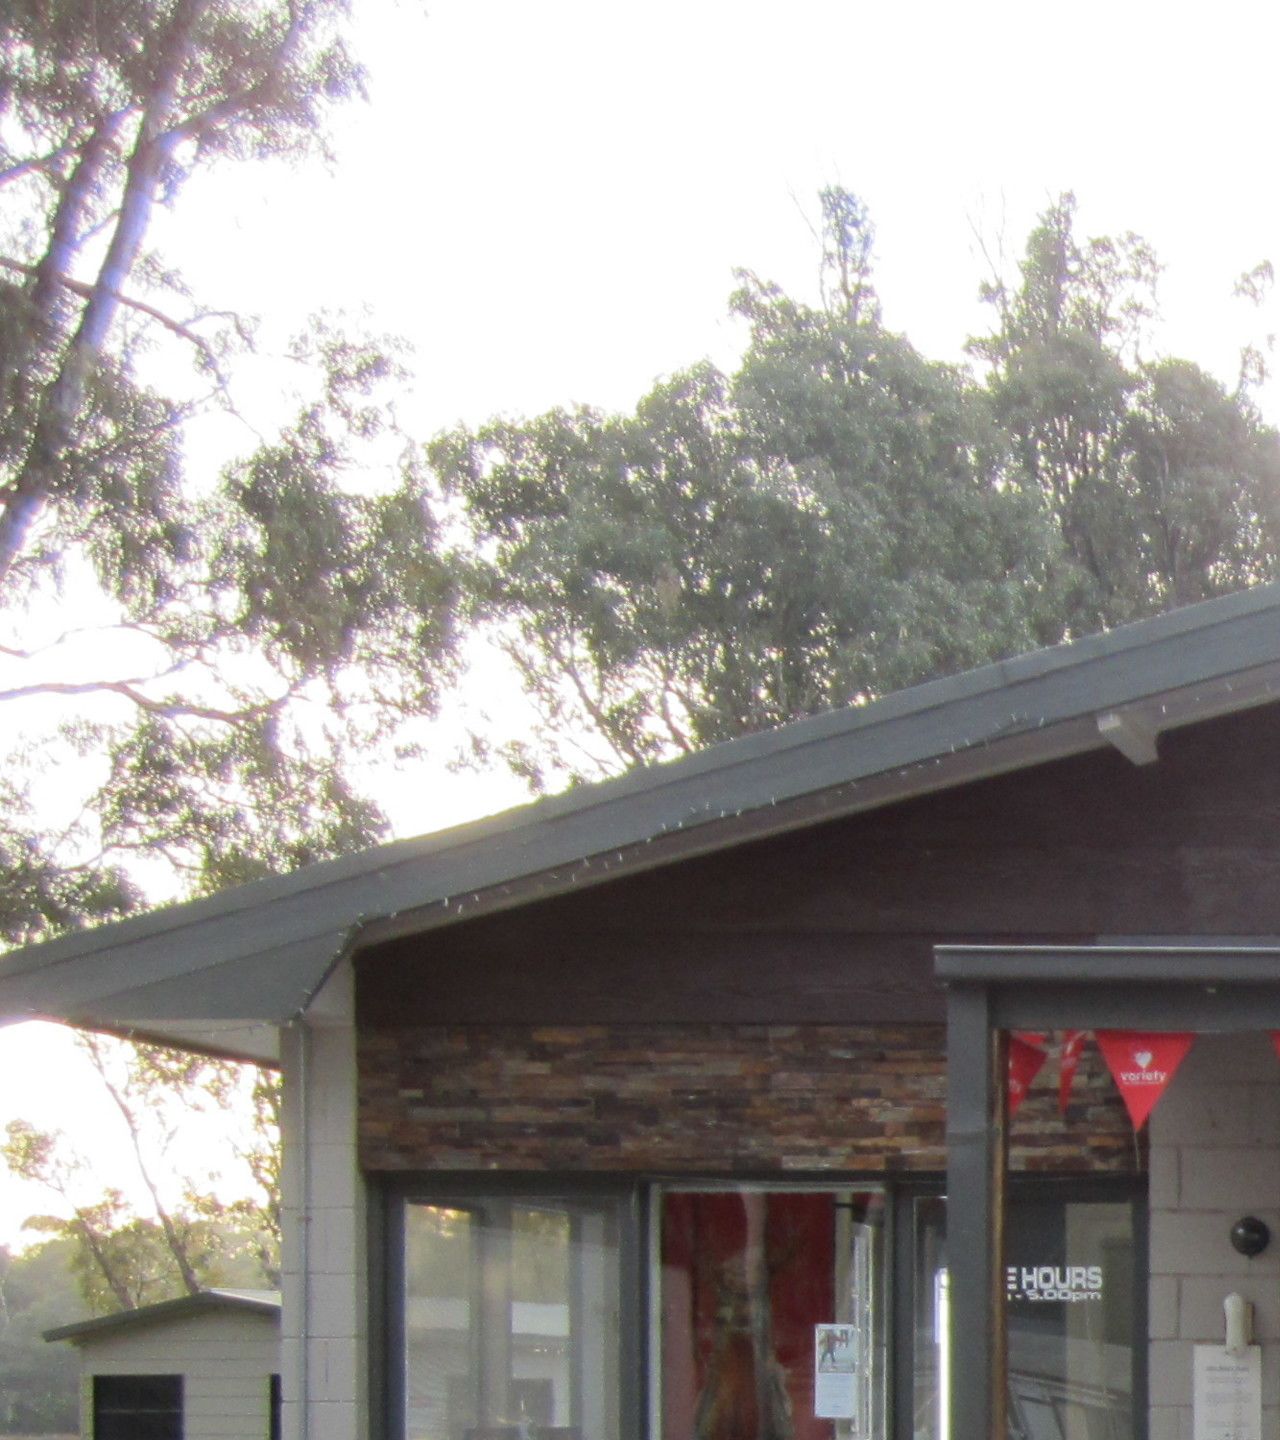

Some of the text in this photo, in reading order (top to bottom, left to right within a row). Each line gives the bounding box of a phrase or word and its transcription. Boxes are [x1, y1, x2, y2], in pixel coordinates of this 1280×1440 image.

[1120, 1070, 1167, 1083] variety
[1021, 1266, 1103, 1290] HOURS
[1026, 1289, 1102, 1302] 5.00pm
